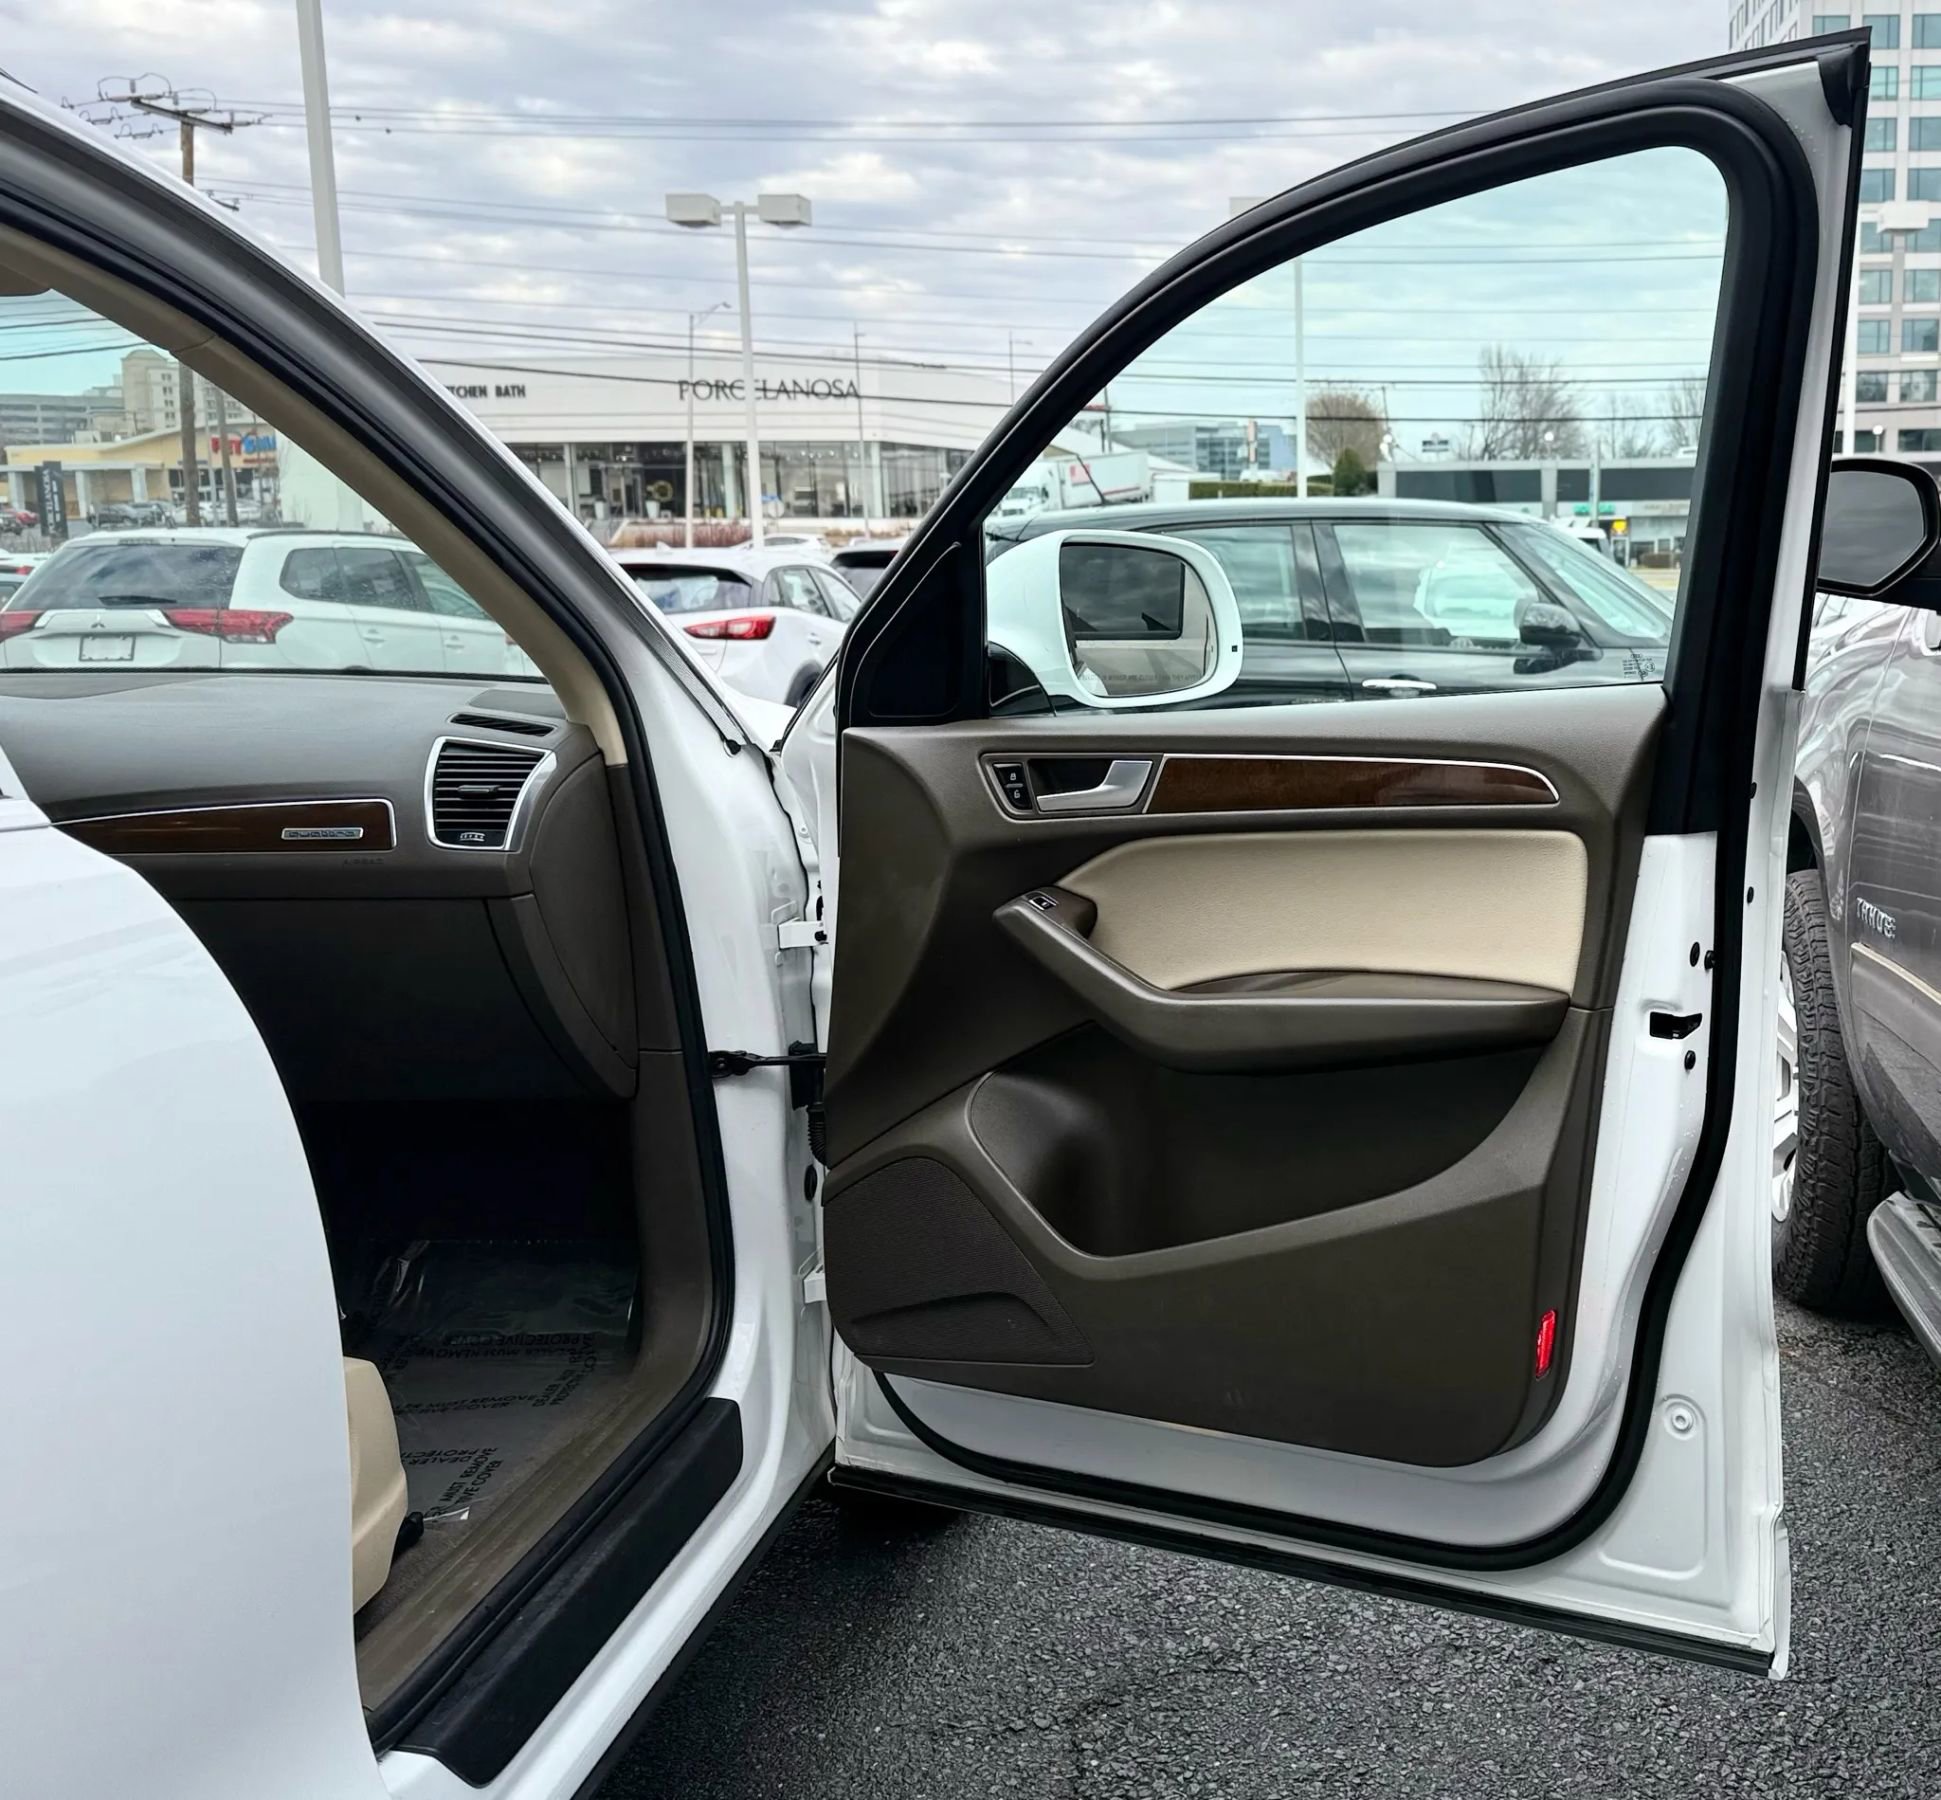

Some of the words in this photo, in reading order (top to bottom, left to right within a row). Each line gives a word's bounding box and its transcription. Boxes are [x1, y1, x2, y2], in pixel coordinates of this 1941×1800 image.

[495, 384, 527, 398] BATH
[1856, 897, 1897, 940] TAHOE
[400, 1448, 479, 1459] PROTECTI
[472, 1460, 504, 1486] COVER
[439, 1481, 466, 1502] MUST
